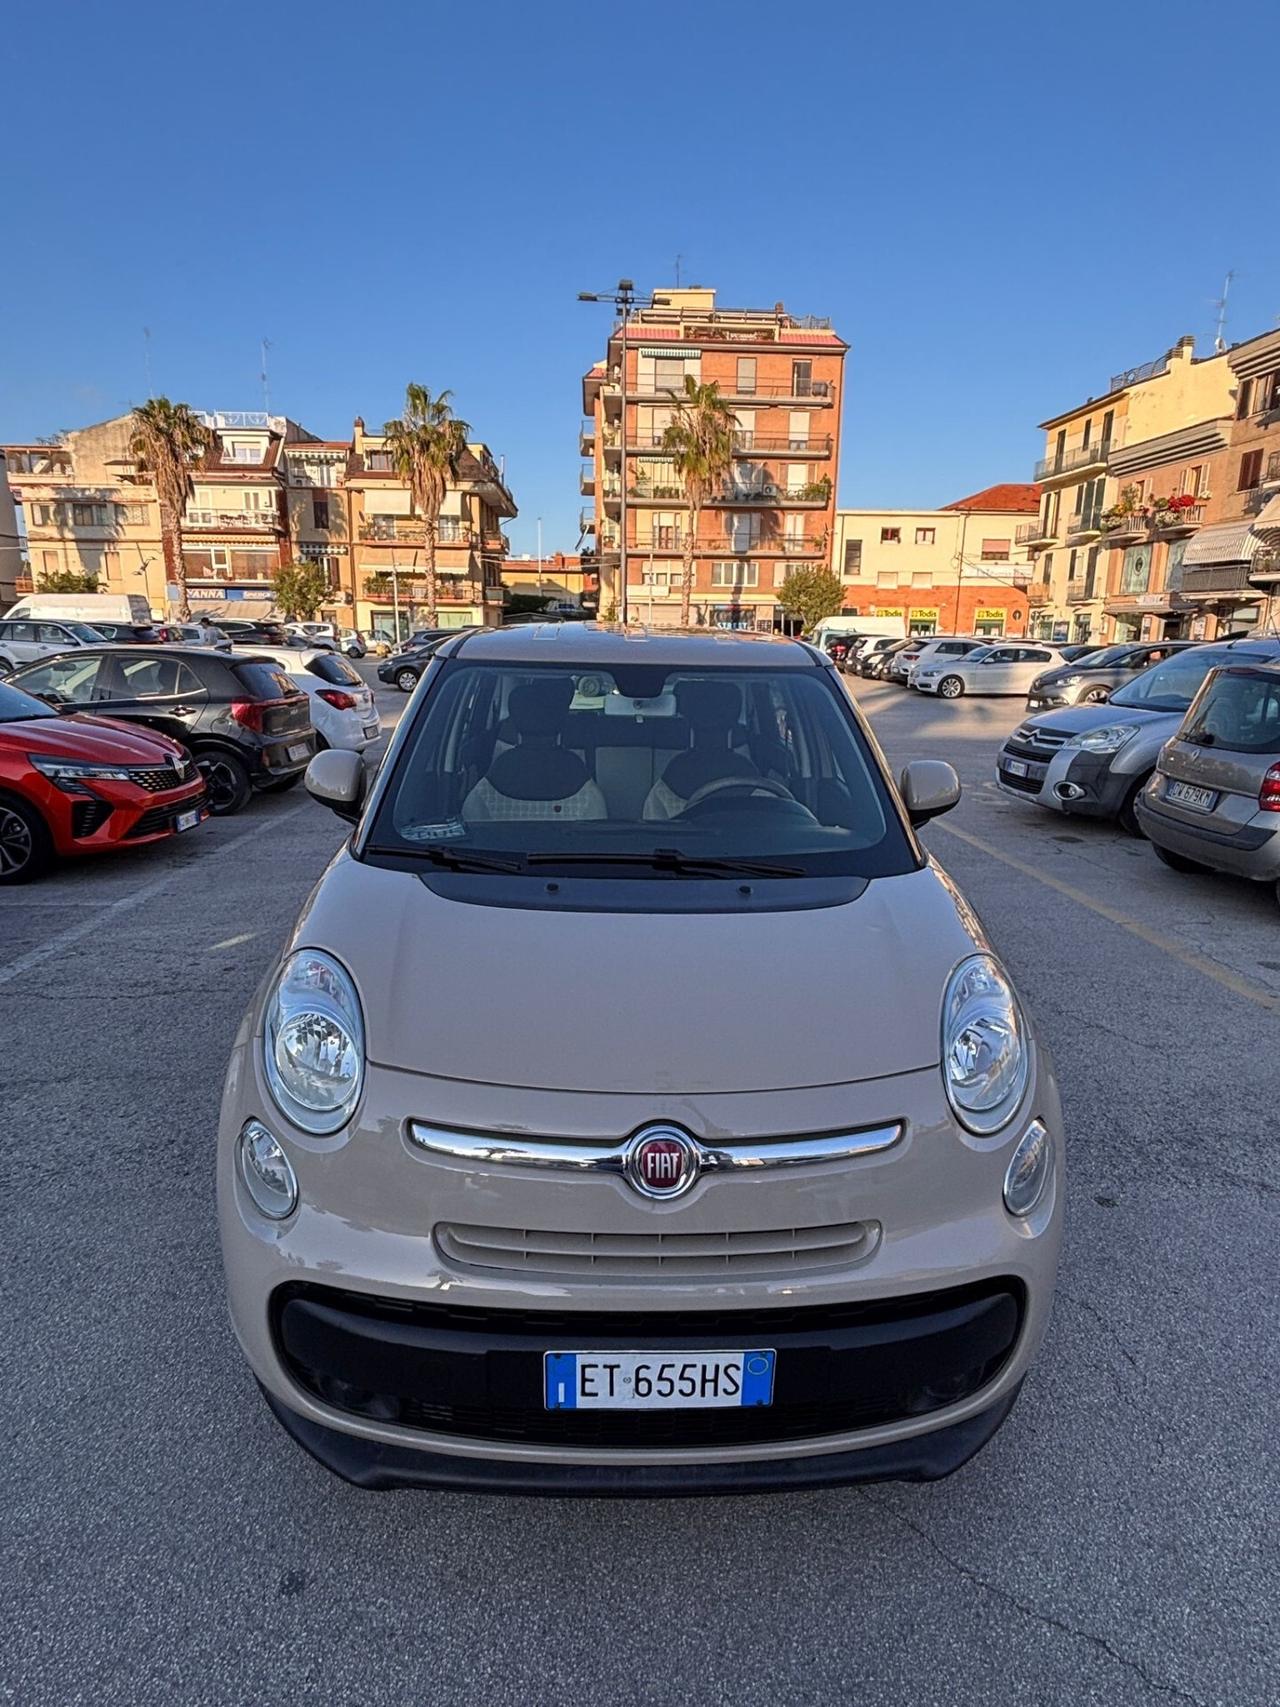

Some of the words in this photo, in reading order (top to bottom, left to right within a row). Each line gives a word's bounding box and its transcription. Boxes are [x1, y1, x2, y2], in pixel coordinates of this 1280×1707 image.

[985, 610, 1003, 618] Todis
[647, 1152, 680, 1179] FIAT
[580, 1363, 621, 1398] ET
[634, 1363, 741, 1398] 655HS
